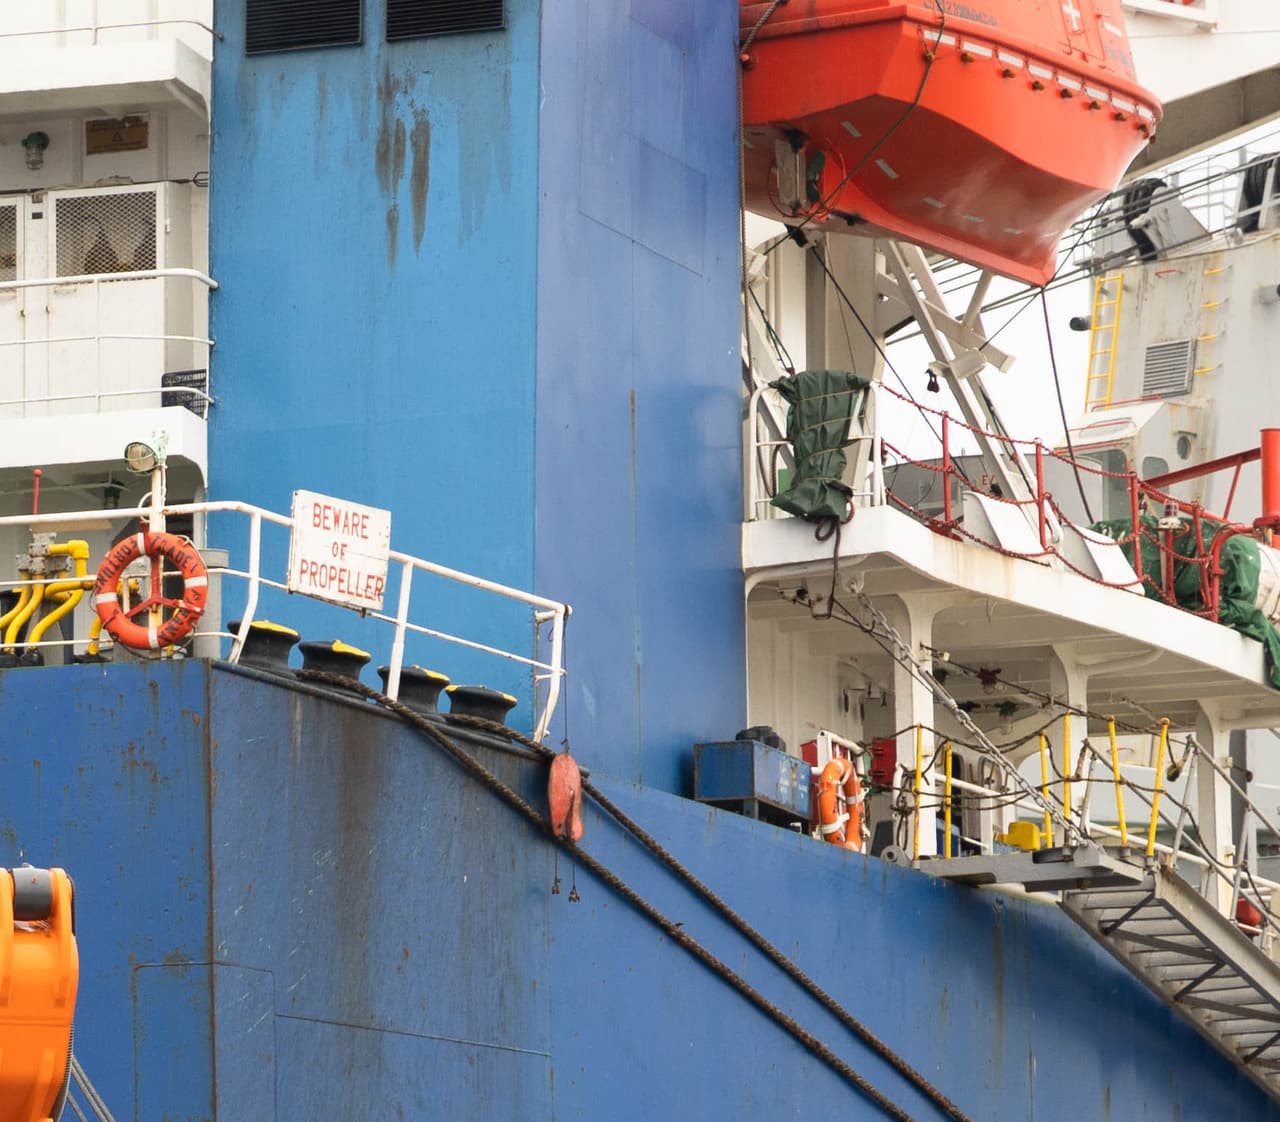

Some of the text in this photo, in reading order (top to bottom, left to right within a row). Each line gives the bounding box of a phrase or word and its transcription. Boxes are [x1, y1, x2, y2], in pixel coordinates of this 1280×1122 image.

[312, 502, 370, 540] BEWARE
[331, 541, 348, 560] OF
[300, 558, 385, 602] PROPELLER
